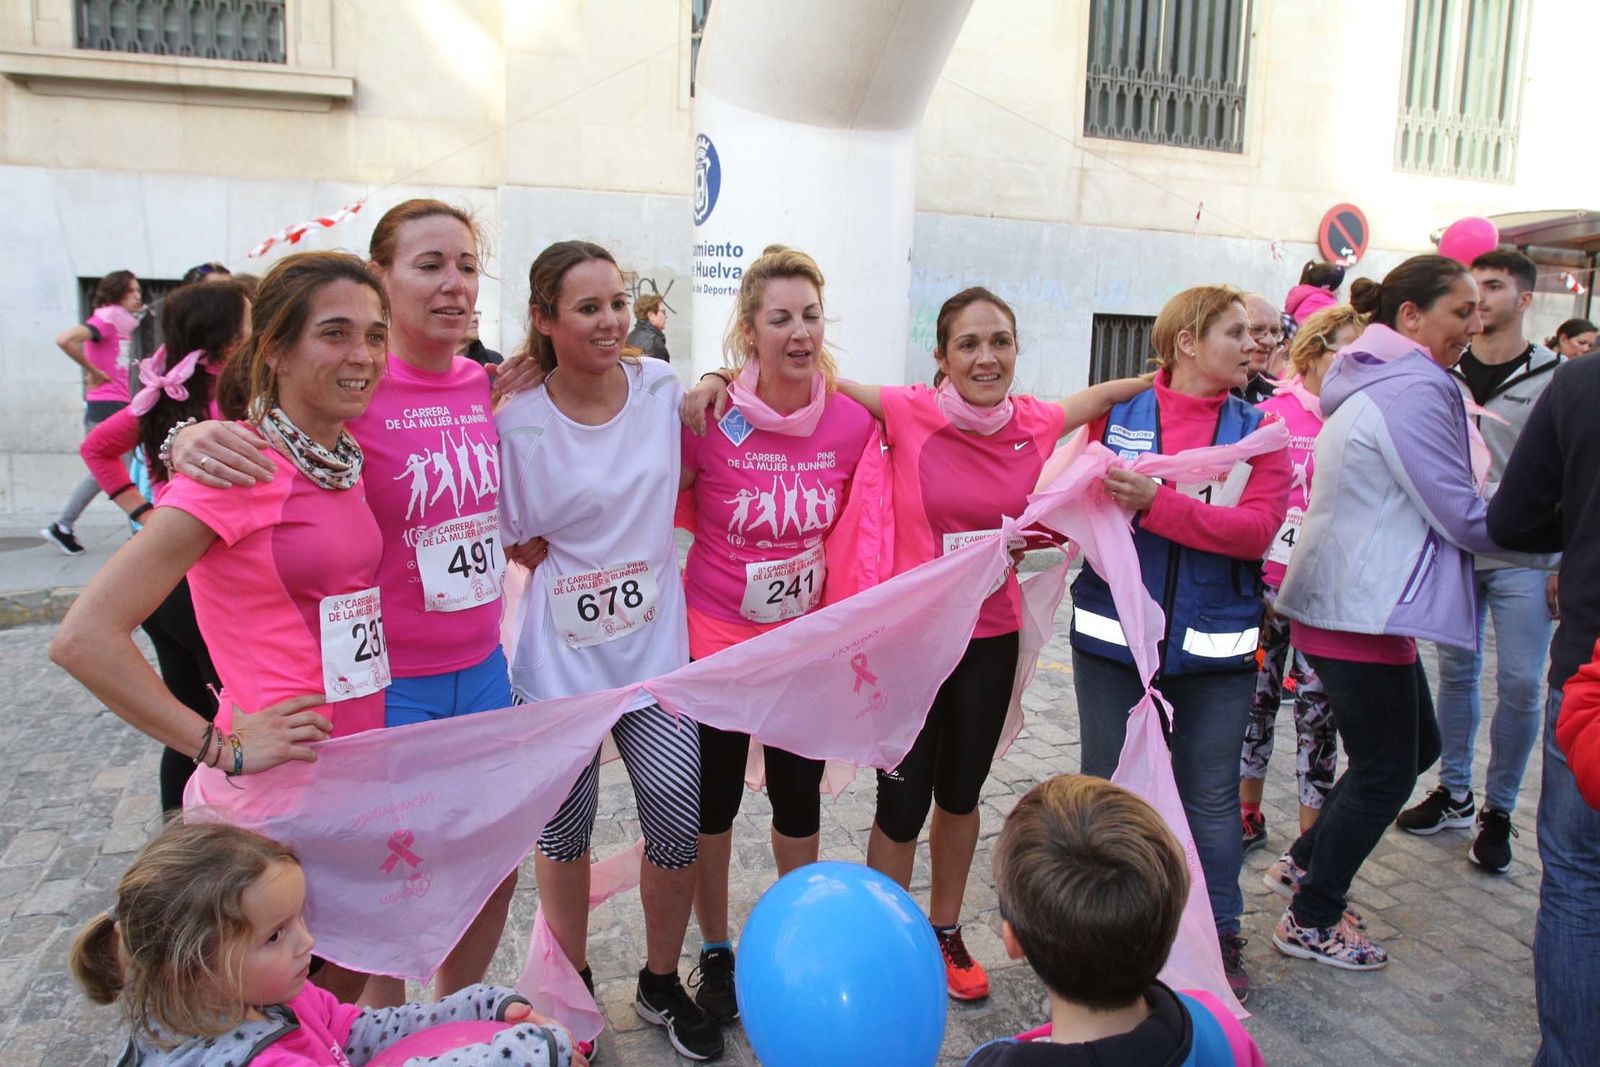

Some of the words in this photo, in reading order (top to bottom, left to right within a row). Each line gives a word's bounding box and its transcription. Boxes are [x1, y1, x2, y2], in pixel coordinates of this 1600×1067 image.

[696, 261, 742, 279] Huelva
[403, 406, 450, 418] CARRERA
[385, 419, 400, 430] DE
[403, 419, 417, 429] LA
[419, 416, 452, 428] MUJER
[727, 458, 740, 468] DE
[742, 461, 754, 470] LA
[756, 462, 788, 472] MUJER
[797, 460, 836, 472] RUNNING
[745, 452, 787, 463] CARRERA
[817, 451, 836, 461] PINK
[438, 520, 475, 535] CARRERA
[422, 537, 434, 548] DE
[435, 535, 447, 545] LA
[449, 528, 476, 542] MUJER
[447, 536, 495, 579] 497
[553, 587, 565, 595] DE
[566, 585, 577, 593] LA
[578, 578, 604, 591] MUJER
[610, 565, 649, 581] RUNNING
[567, 571, 603, 585] CARRERA
[627, 560, 647, 569] PINK
[764, 571, 773, 579] LA
[766, 569, 814, 605] 241
[577, 580, 643, 622] 678
[328, 611, 341, 622] DE
[343, 609, 355, 620] LA
